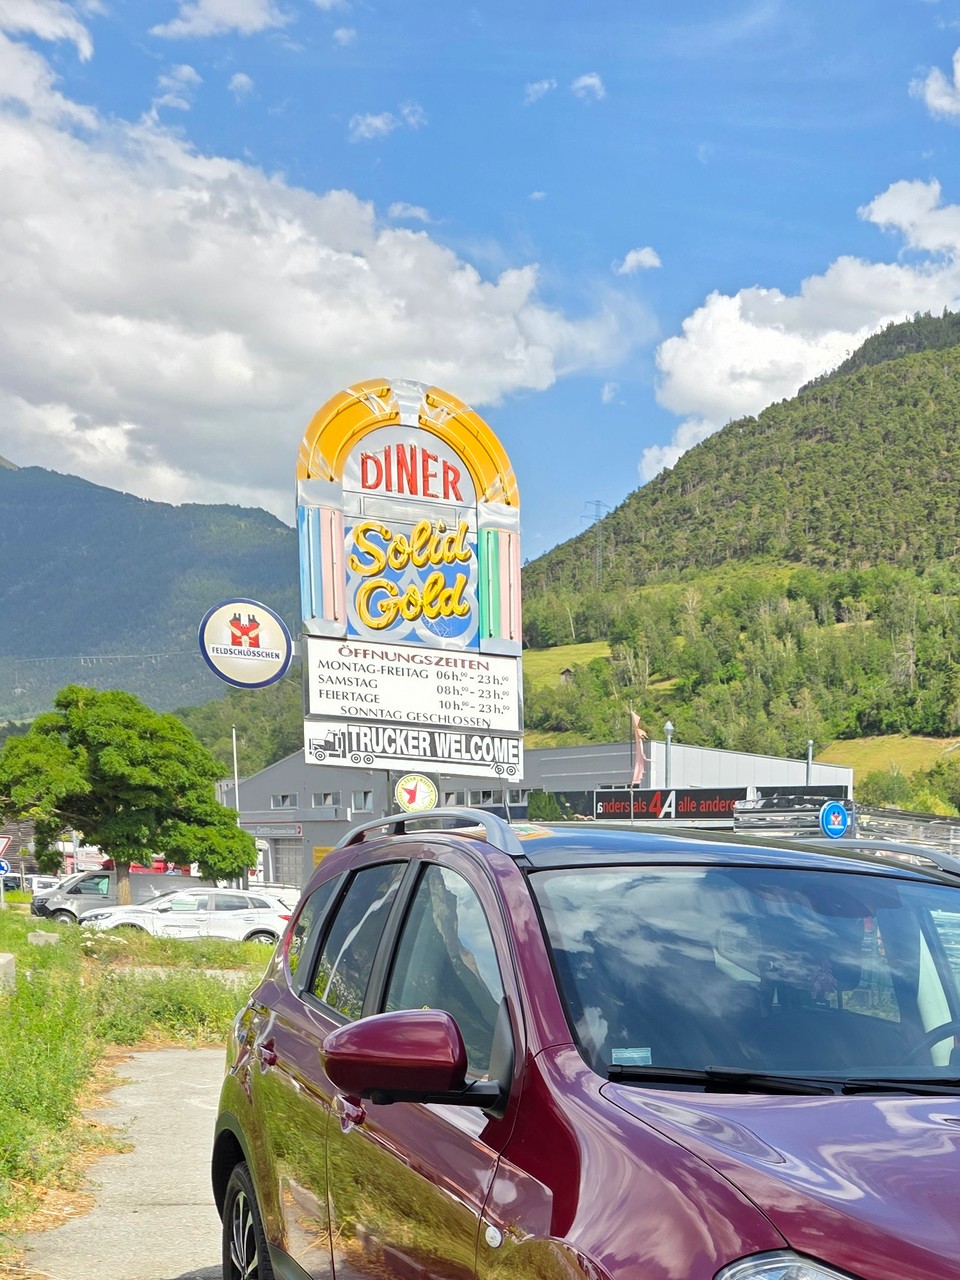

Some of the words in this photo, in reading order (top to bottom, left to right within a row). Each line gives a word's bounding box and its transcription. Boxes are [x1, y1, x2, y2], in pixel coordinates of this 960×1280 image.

[360, 443, 464, 502] DINER
[348, 519, 472, 577] Solid
[356, 571, 470, 630] Gold
[211, 646, 280, 660] FELDSCHLÖSSCHEN
[338, 644, 490, 671] ÖFFNUNGSZEITEN
[318, 659, 429, 679] MONTAG-FREITAG
[318, 673, 378, 689] SAMSTAG
[319, 688, 381, 704] FEIERTAGE
[340, 705, 402, 720] SONNTAG
[406, 711, 491, 727] GESCHLOSSEN
[349, 725, 431, 757] TRUCKER
[434, 732, 520, 764] WELCOME
[597, 797, 630, 814] anders
[634, 797, 647, 813] als
[677, 795, 697, 813] alle
